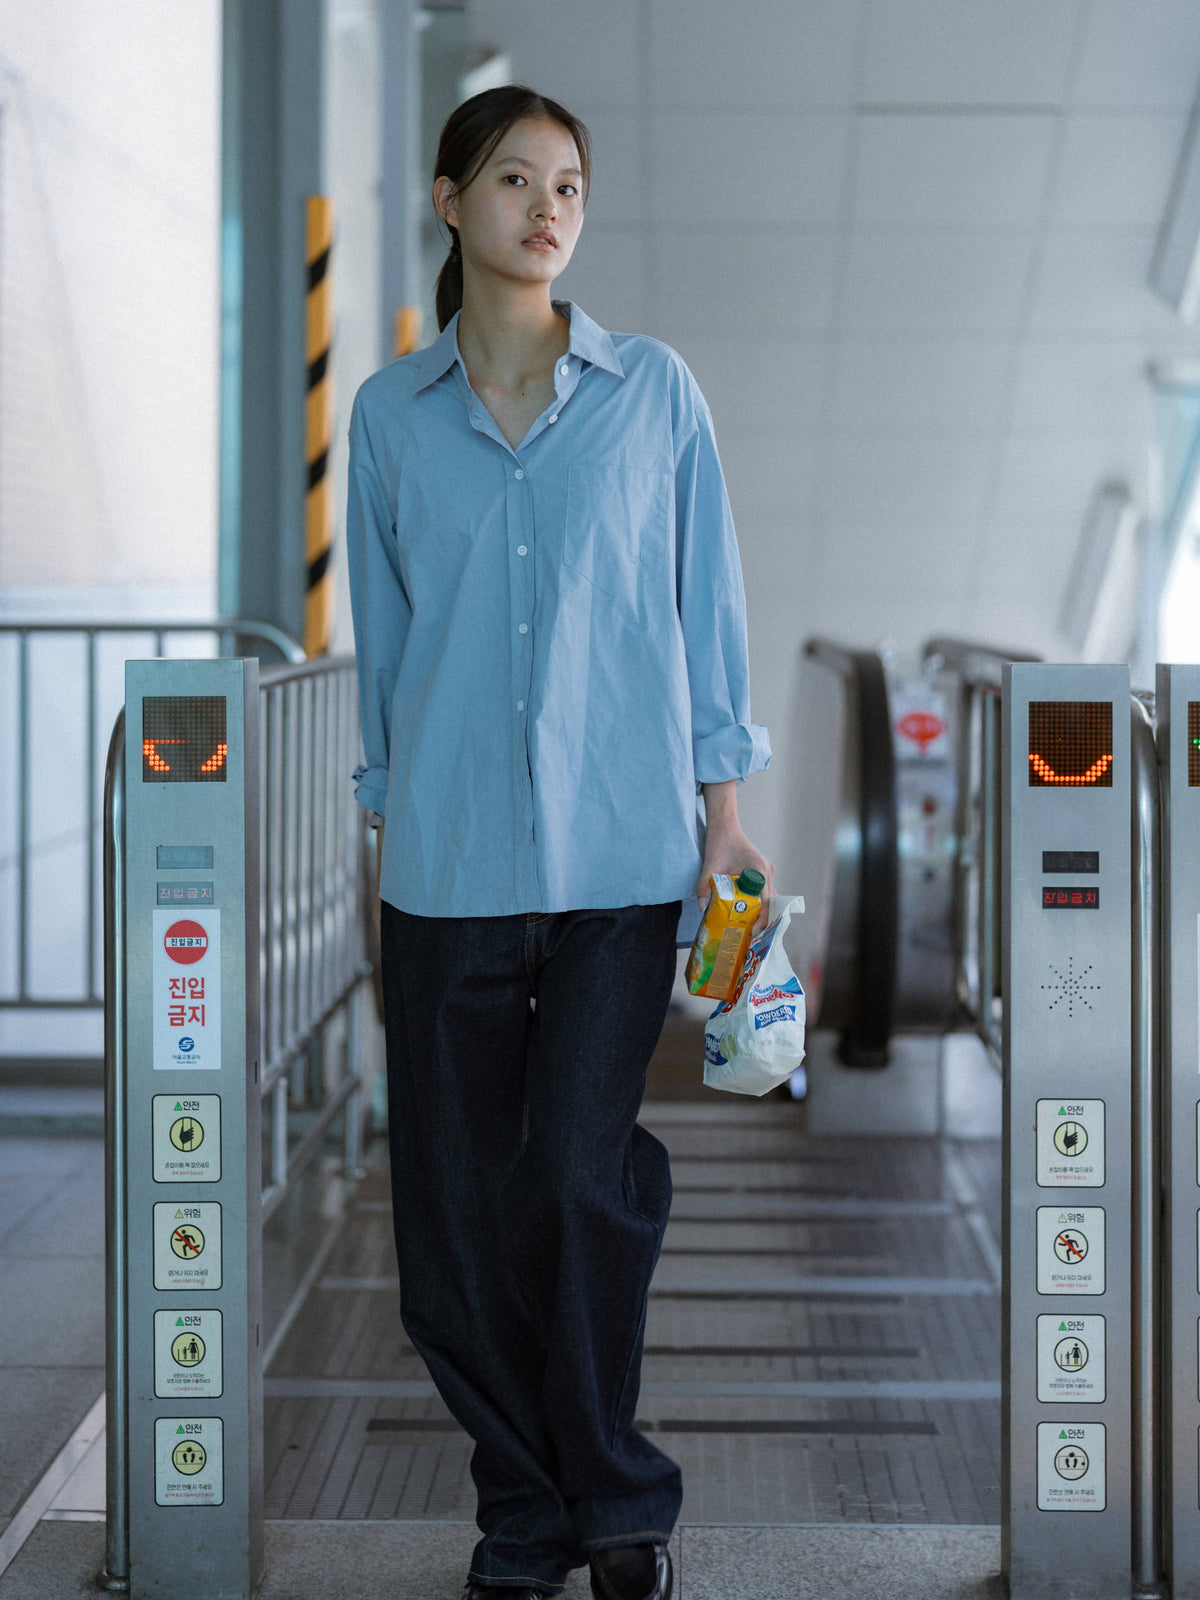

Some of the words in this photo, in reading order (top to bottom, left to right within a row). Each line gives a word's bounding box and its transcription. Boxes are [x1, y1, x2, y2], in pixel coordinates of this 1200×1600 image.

[160, 888, 212, 899] 진입금지
[1044, 893, 1096, 903] 진입금지
[170, 938, 202, 947] 진입금지
[168, 977, 205, 999] 진입
[168, 1004, 205, 1026] 금지
[183, 1101, 200, 1111] 안전
[1067, 1105, 1084, 1115] 안전
[184, 1208, 201, 1218] 위험
[1067, 1213, 1085, 1223] 위험
[184, 1316, 201, 1326] 안전
[1067, 1321, 1084, 1331] 안전
[185, 1424, 202, 1434] 안전
[1068, 1429, 1085, 1439] 안전
